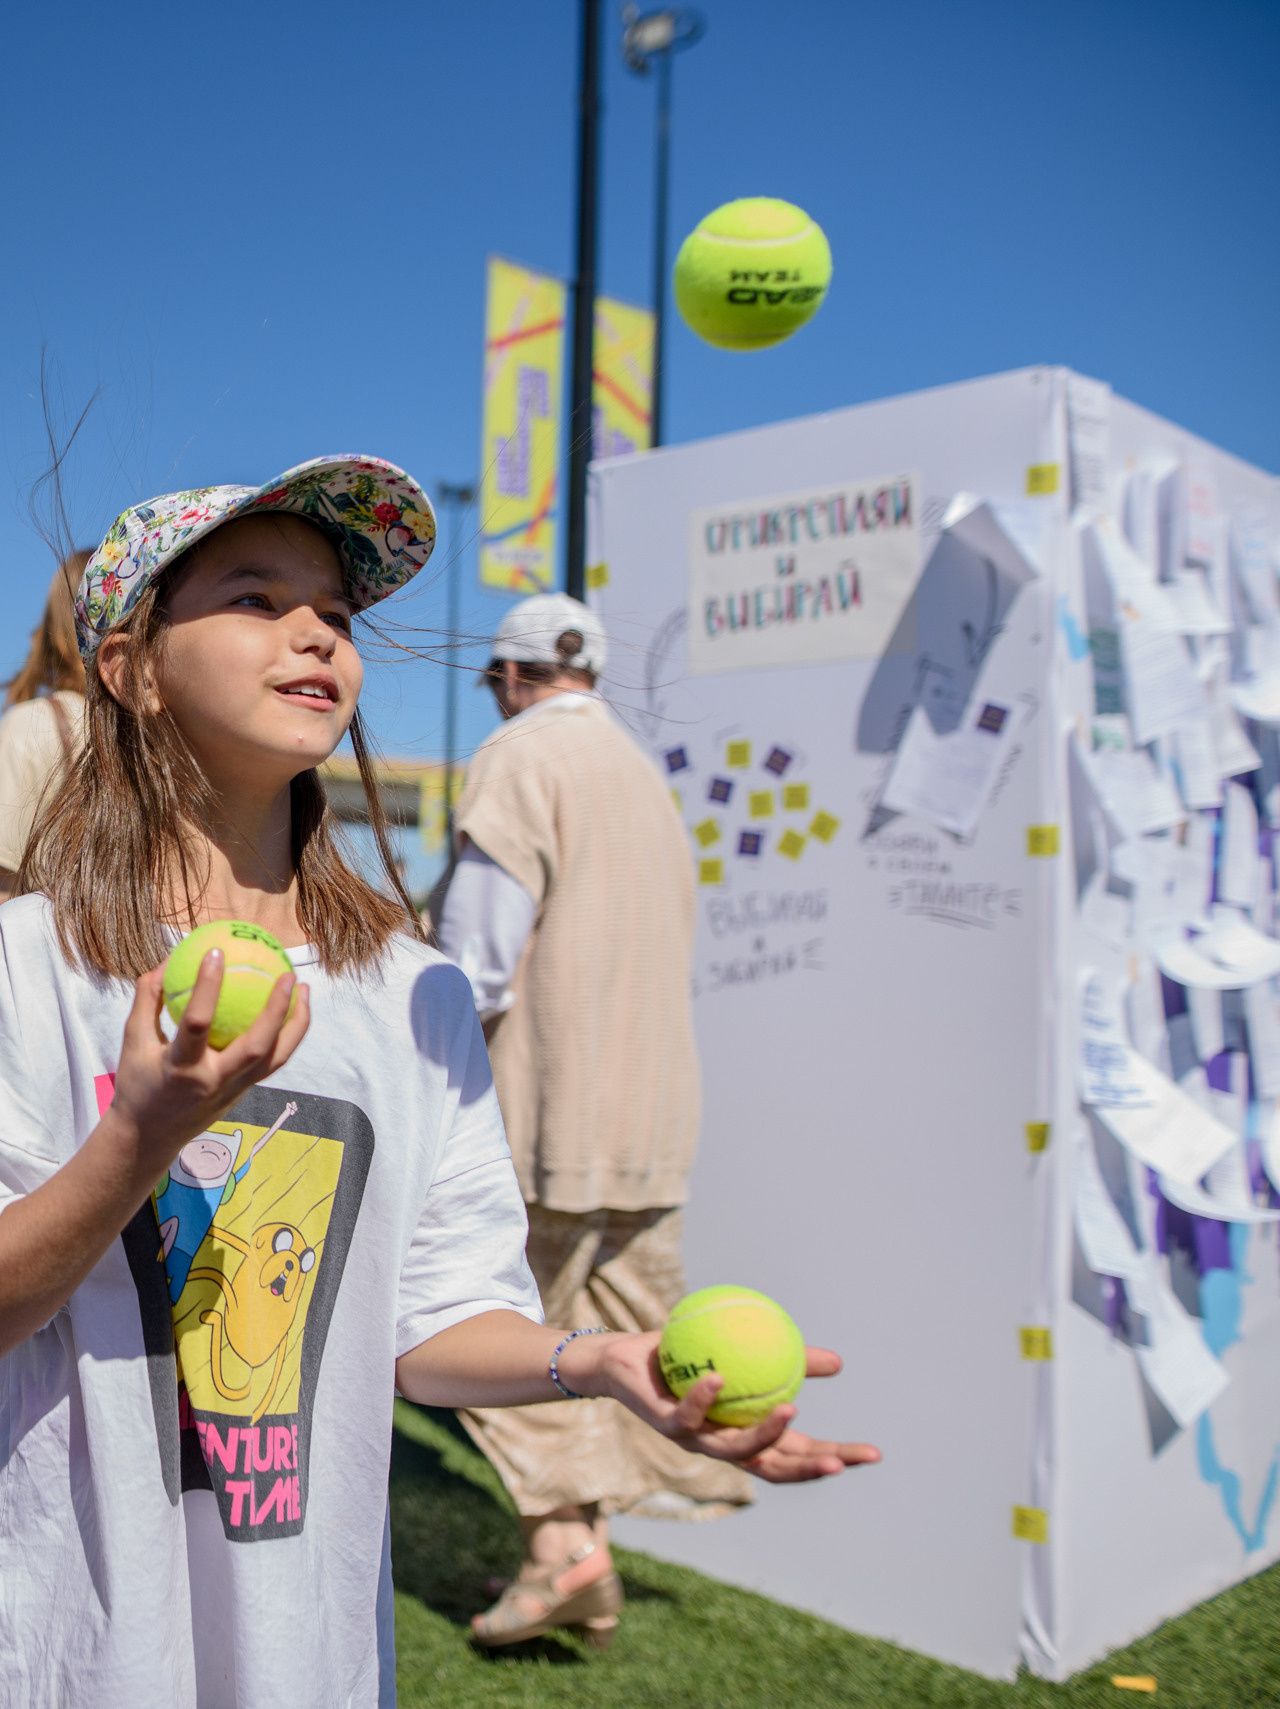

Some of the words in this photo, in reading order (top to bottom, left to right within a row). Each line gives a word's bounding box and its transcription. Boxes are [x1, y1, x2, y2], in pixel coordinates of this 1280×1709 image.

[728, 268, 801, 284] TEAM
[704, 559, 863, 638] ВЫБИРАЙ
[224, 1476, 302, 1528] TIME
